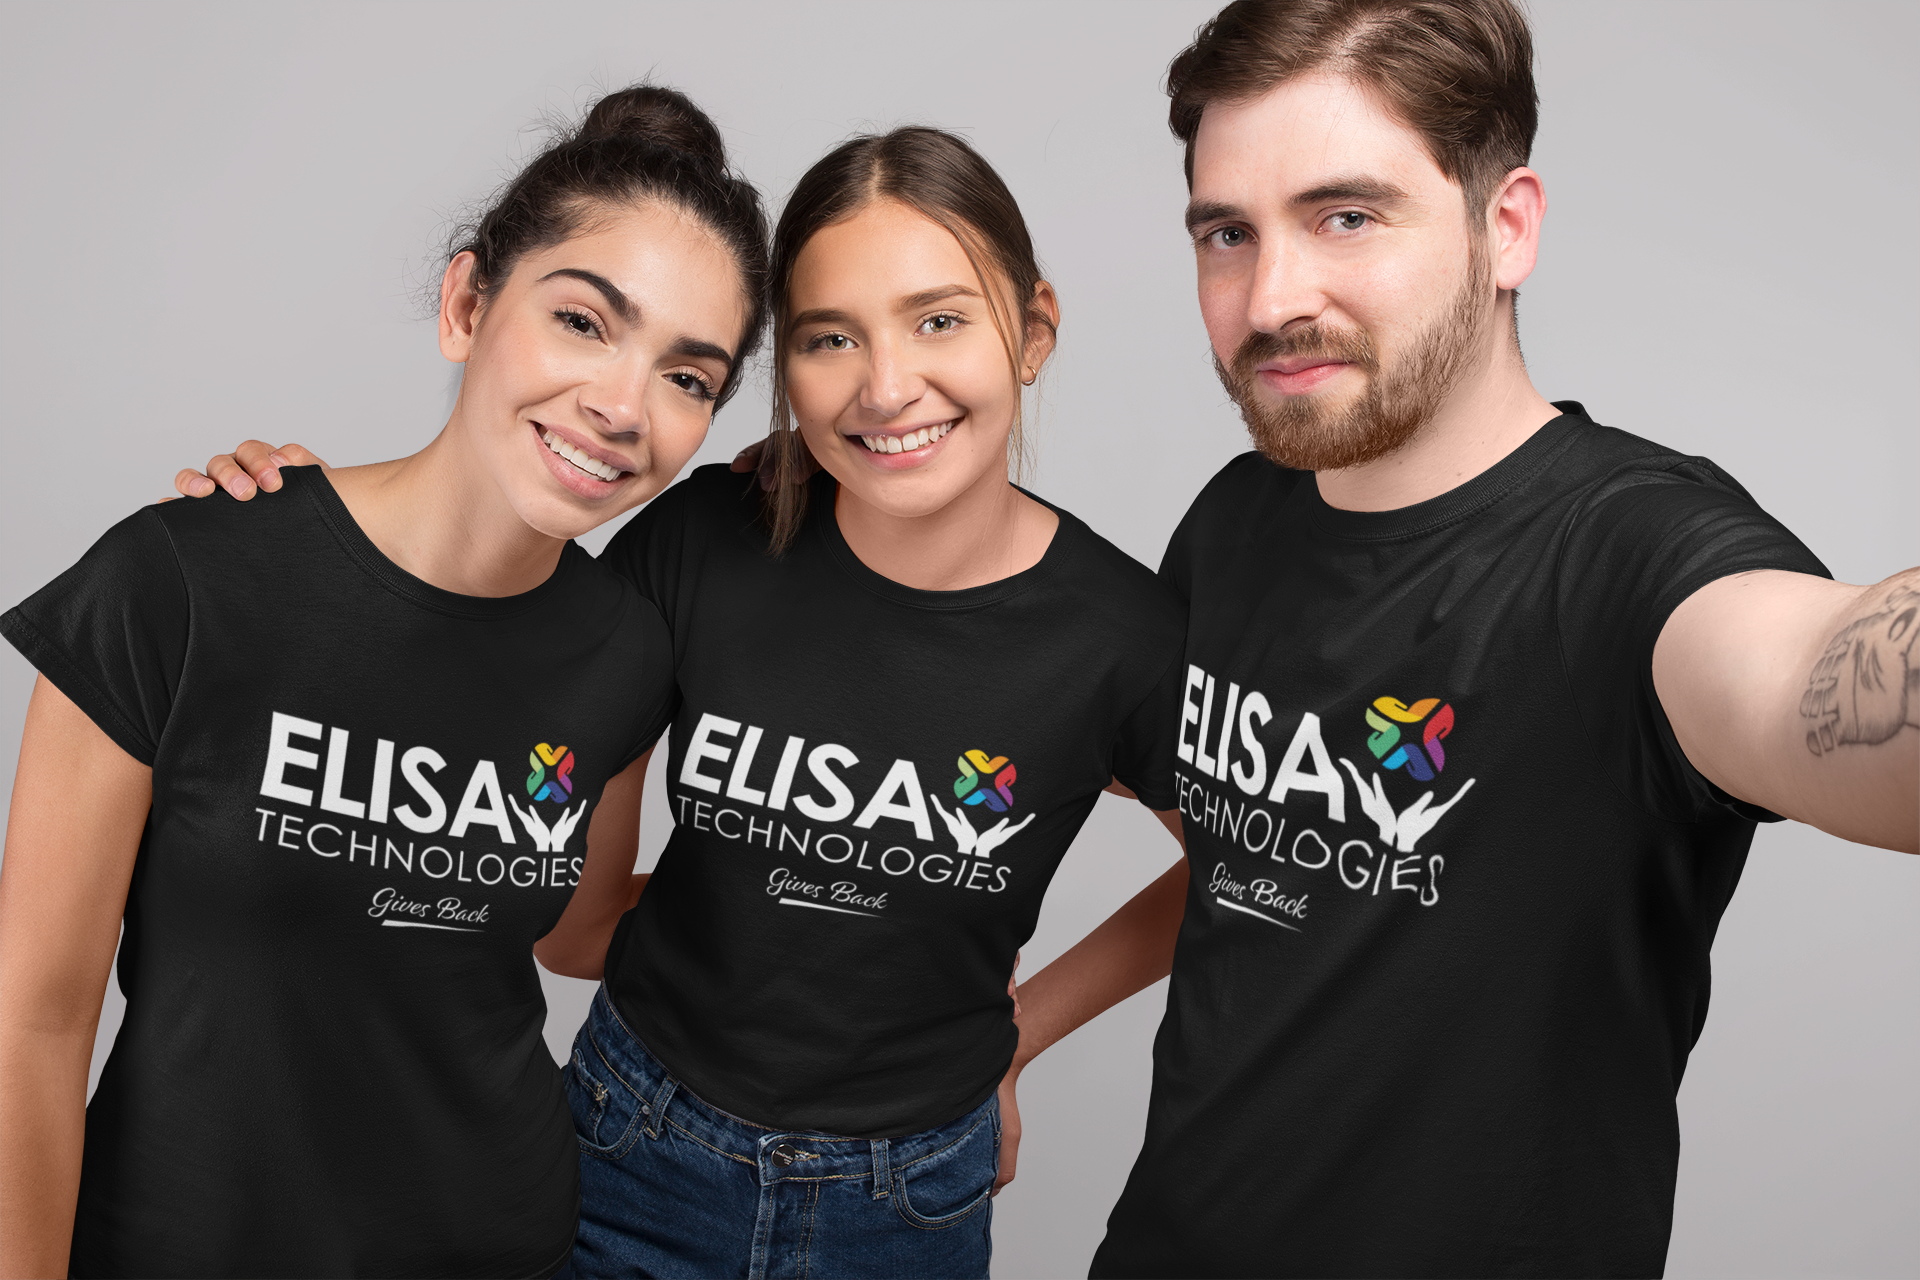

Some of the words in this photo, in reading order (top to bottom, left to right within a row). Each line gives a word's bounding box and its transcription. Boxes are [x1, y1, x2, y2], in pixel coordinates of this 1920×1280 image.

[260, 711, 517, 845] ELISA
[679, 712, 935, 842] ELISA
[1177, 664, 1346, 824] ELISA
[255, 807, 584, 888] TECHNOLOGIES
[676, 794, 1012, 893] TECHNOLOGIES
[766, 867, 824, 898] Gives
[830, 881, 888, 910] Back
[367, 887, 432, 918] Gives
[437, 897, 490, 923] Back
[1208, 862, 1247, 901] Gives
[1250, 878, 1309, 919] Back
